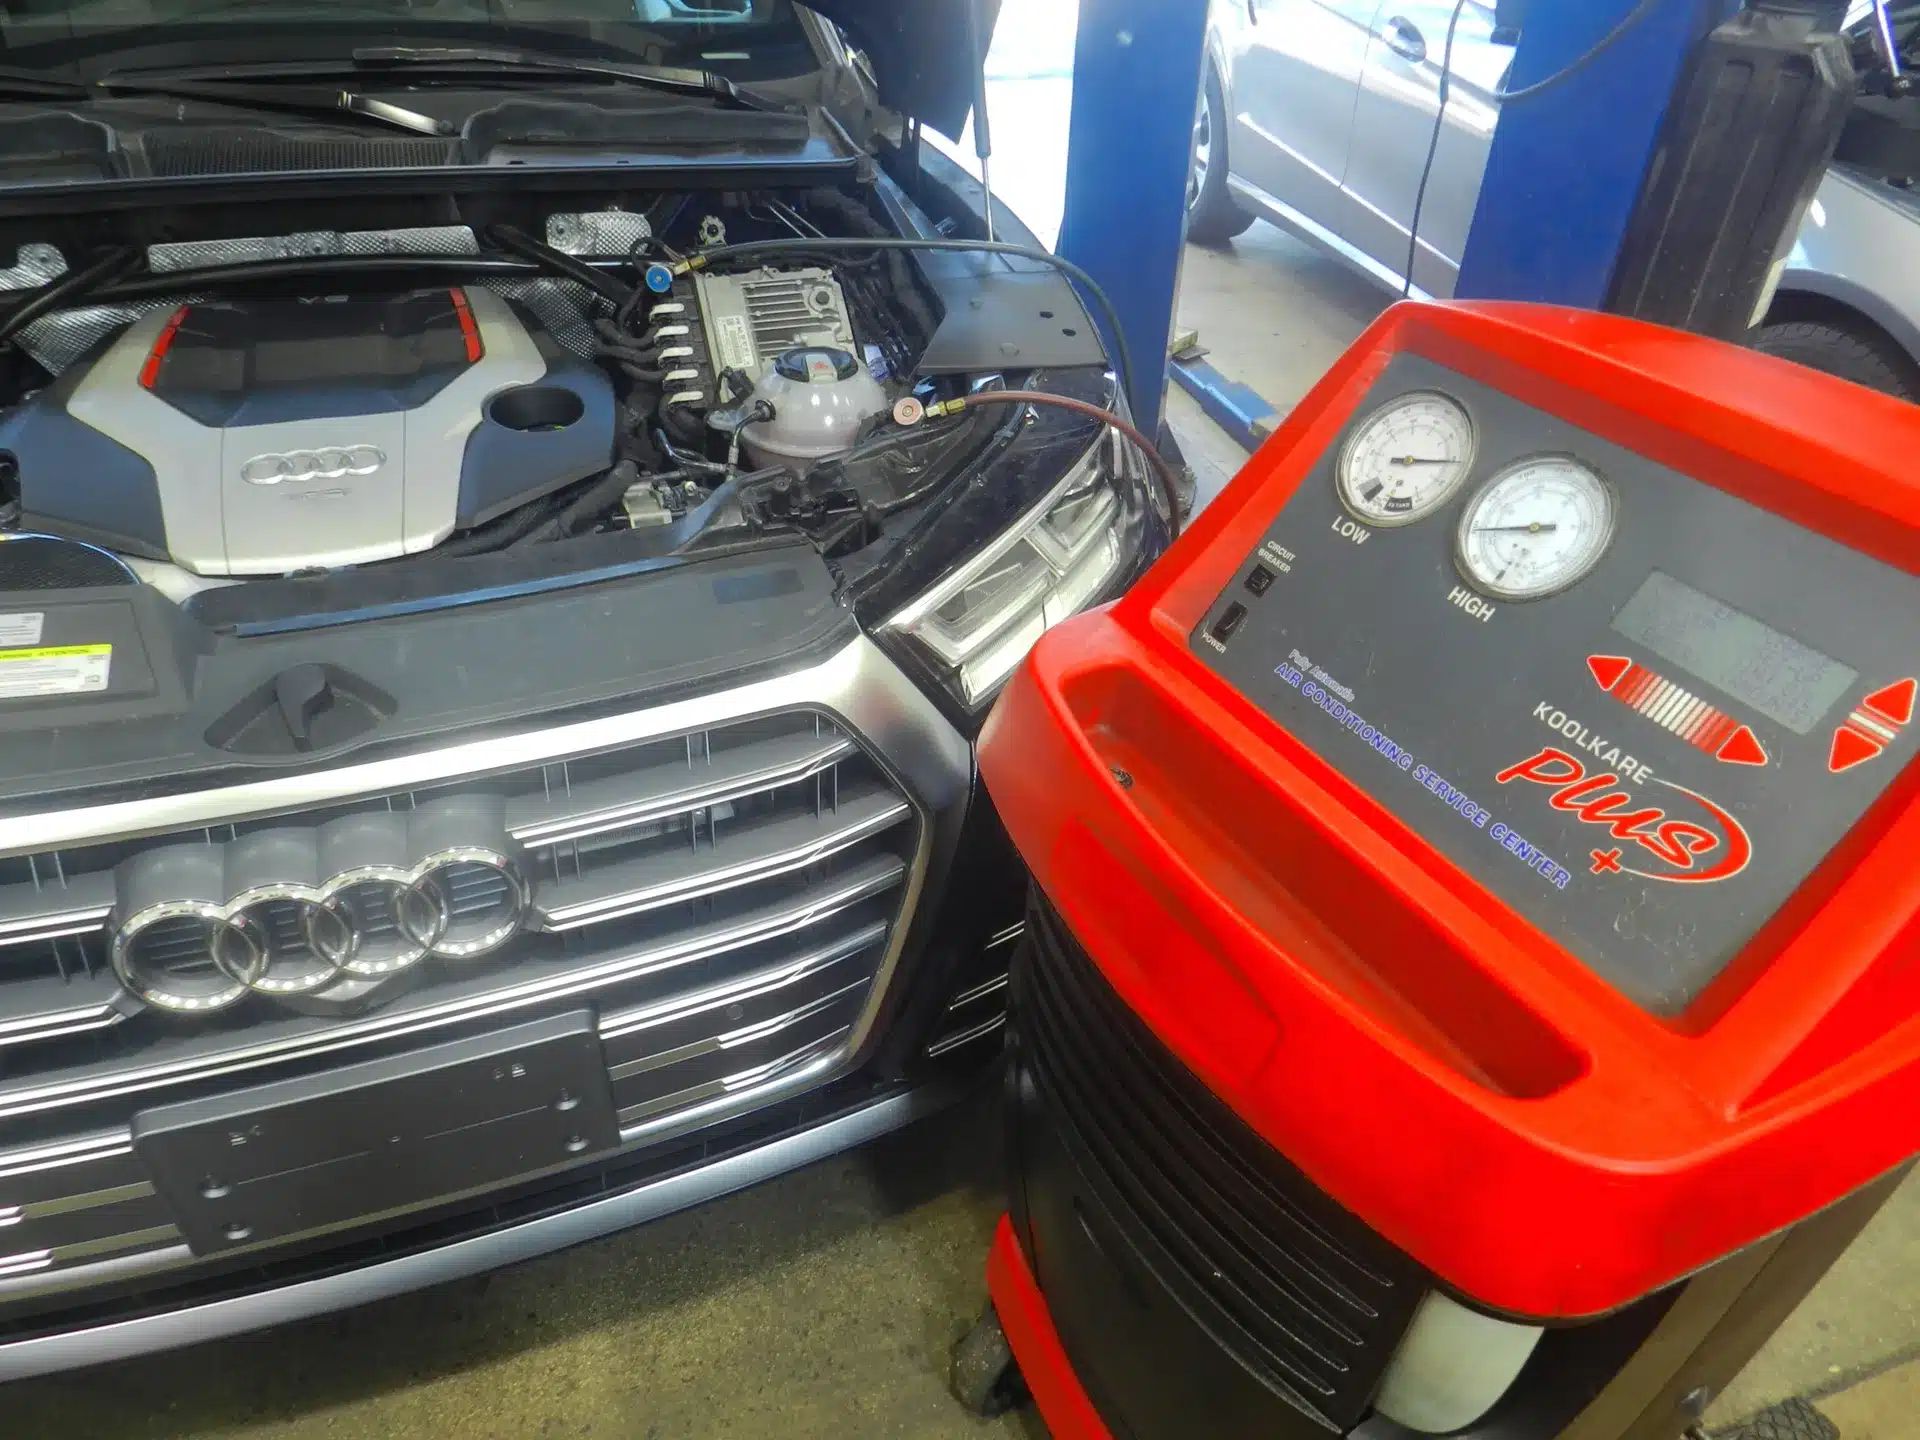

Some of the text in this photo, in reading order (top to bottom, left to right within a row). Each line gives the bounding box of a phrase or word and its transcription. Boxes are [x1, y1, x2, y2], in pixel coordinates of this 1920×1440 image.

[1331, 515, 1371, 545] LOW
[1258, 547, 1291, 574] BREAKER
[1267, 540, 1296, 562] CIRCUIT
[1447, 585, 1496, 622] HIGH
[1201, 632, 1227, 654] POWER
[1288, 648, 1312, 671] Fully
[1532, 701, 1653, 784] KOOLKARE
[1273, 661, 1571, 889] AIR CONDITIONING SERVICE CENTER
